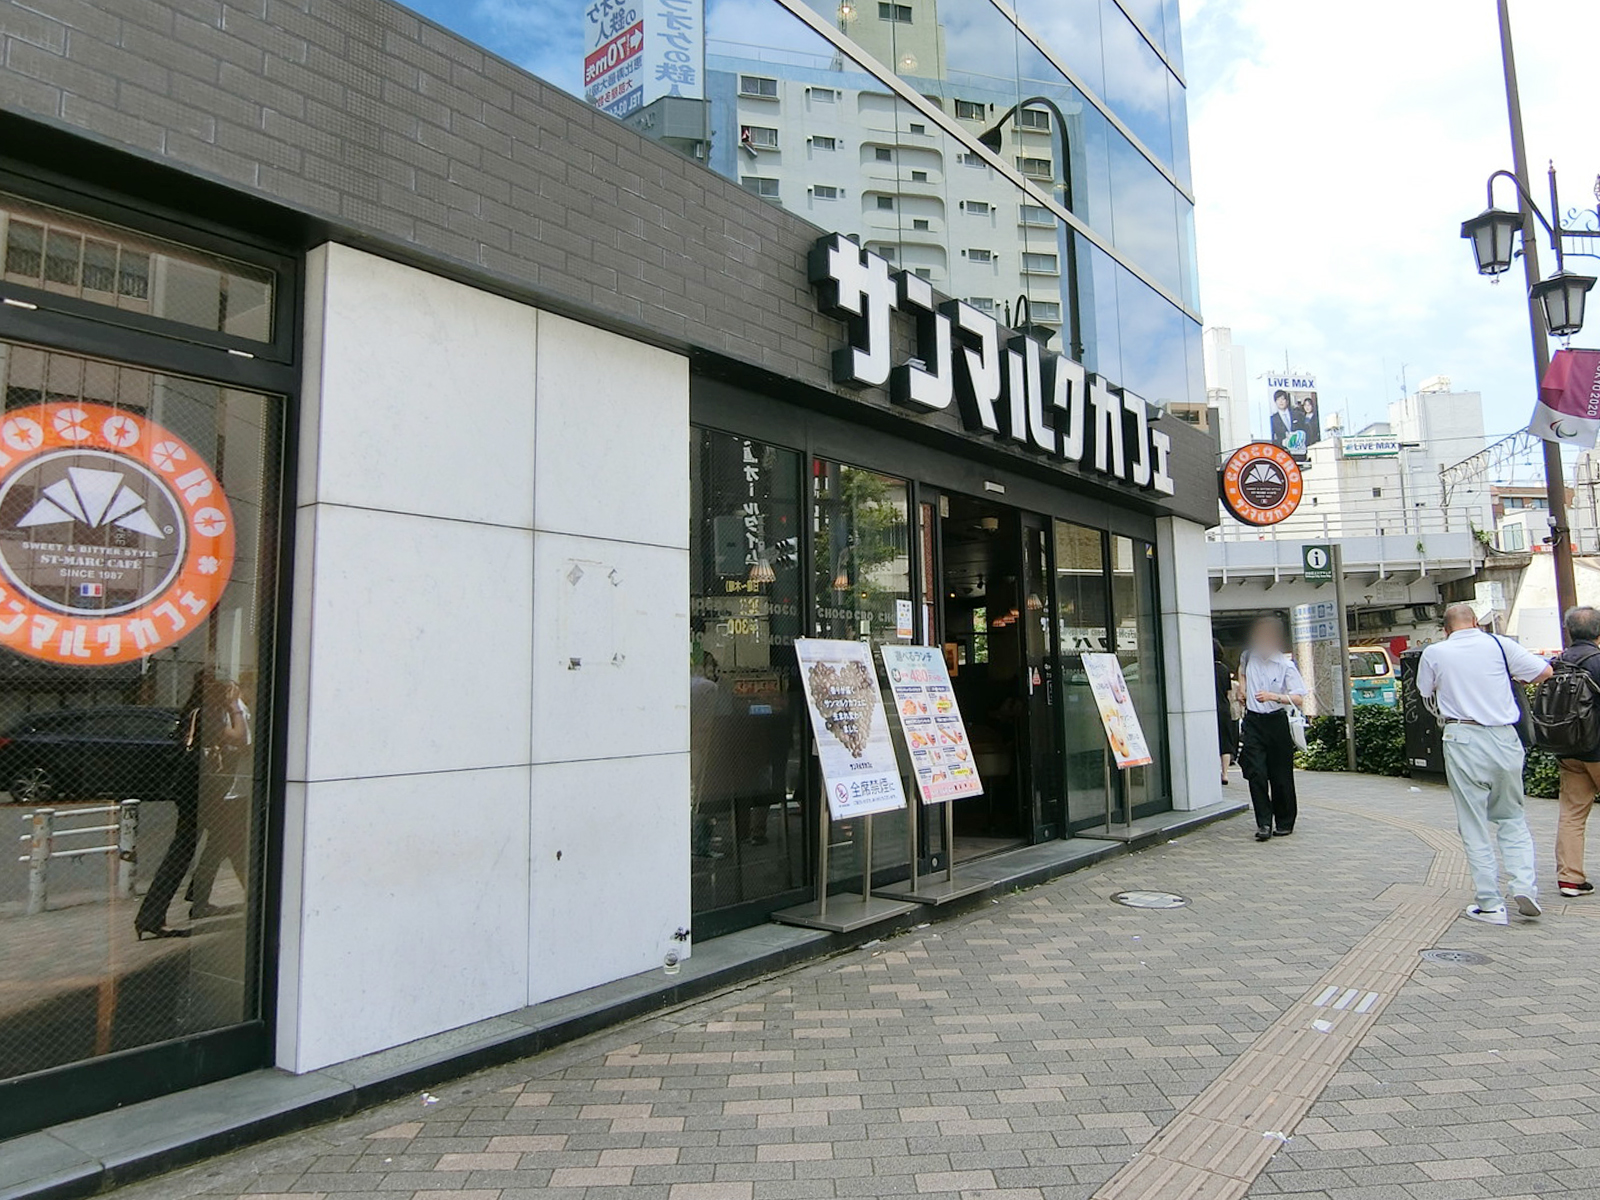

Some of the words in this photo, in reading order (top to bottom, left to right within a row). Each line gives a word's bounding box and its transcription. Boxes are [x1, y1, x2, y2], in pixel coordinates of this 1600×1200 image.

[829, 233, 1174, 496] サンマルクカフェ
[1292, 378, 1315, 388] MAX
[1587, 393, 1600, 416] 2020
[1376, 442, 1396, 450] MAX
[22, 541, 63, 552] SWEET
[67, 545, 76, 553] &
[80, 545, 121, 556] BITTER
[125, 548, 159, 558] STYLE
[40, 555, 104, 568] ST-MARC
[59, 567, 95, 578] SINCE
[99, 570, 124, 580] 1987
